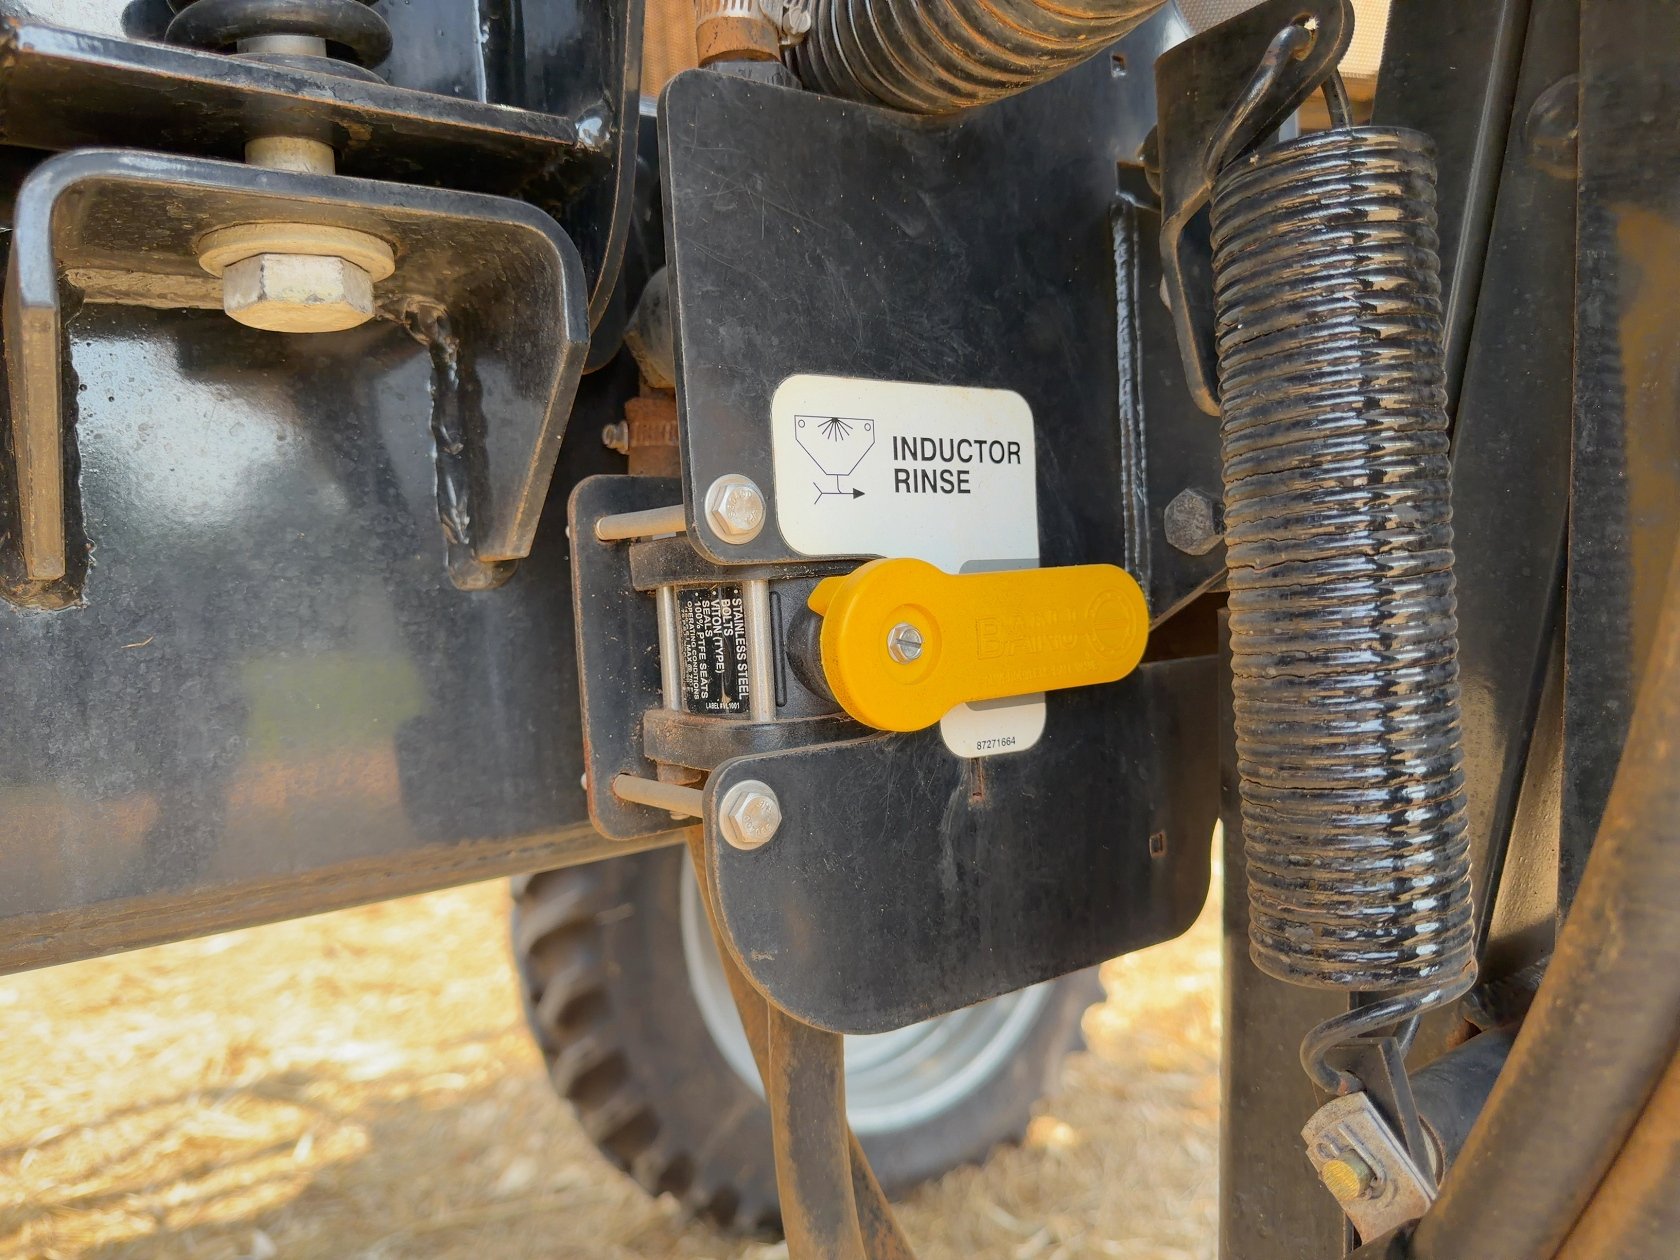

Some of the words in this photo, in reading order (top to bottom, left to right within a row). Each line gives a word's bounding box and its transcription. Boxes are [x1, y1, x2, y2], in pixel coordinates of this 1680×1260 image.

[892, 436, 1022, 465] INDUCTOR
[894, 468, 971, 494] RINSE
[694, 601, 704, 629] 100%
[702, 600, 712, 637] SEALS
[711, 599, 722, 634] VITON
[721, 599, 733, 637] BOLTS
[732, 598, 746, 661] STAINLESS
[697, 631, 706, 660] PTFE
[713, 636, 725, 674] (TYPE)
[699, 662, 709, 699] SEATS
[737, 663, 749, 700] STEEL
[976, 736, 1016, 751] 87271664
